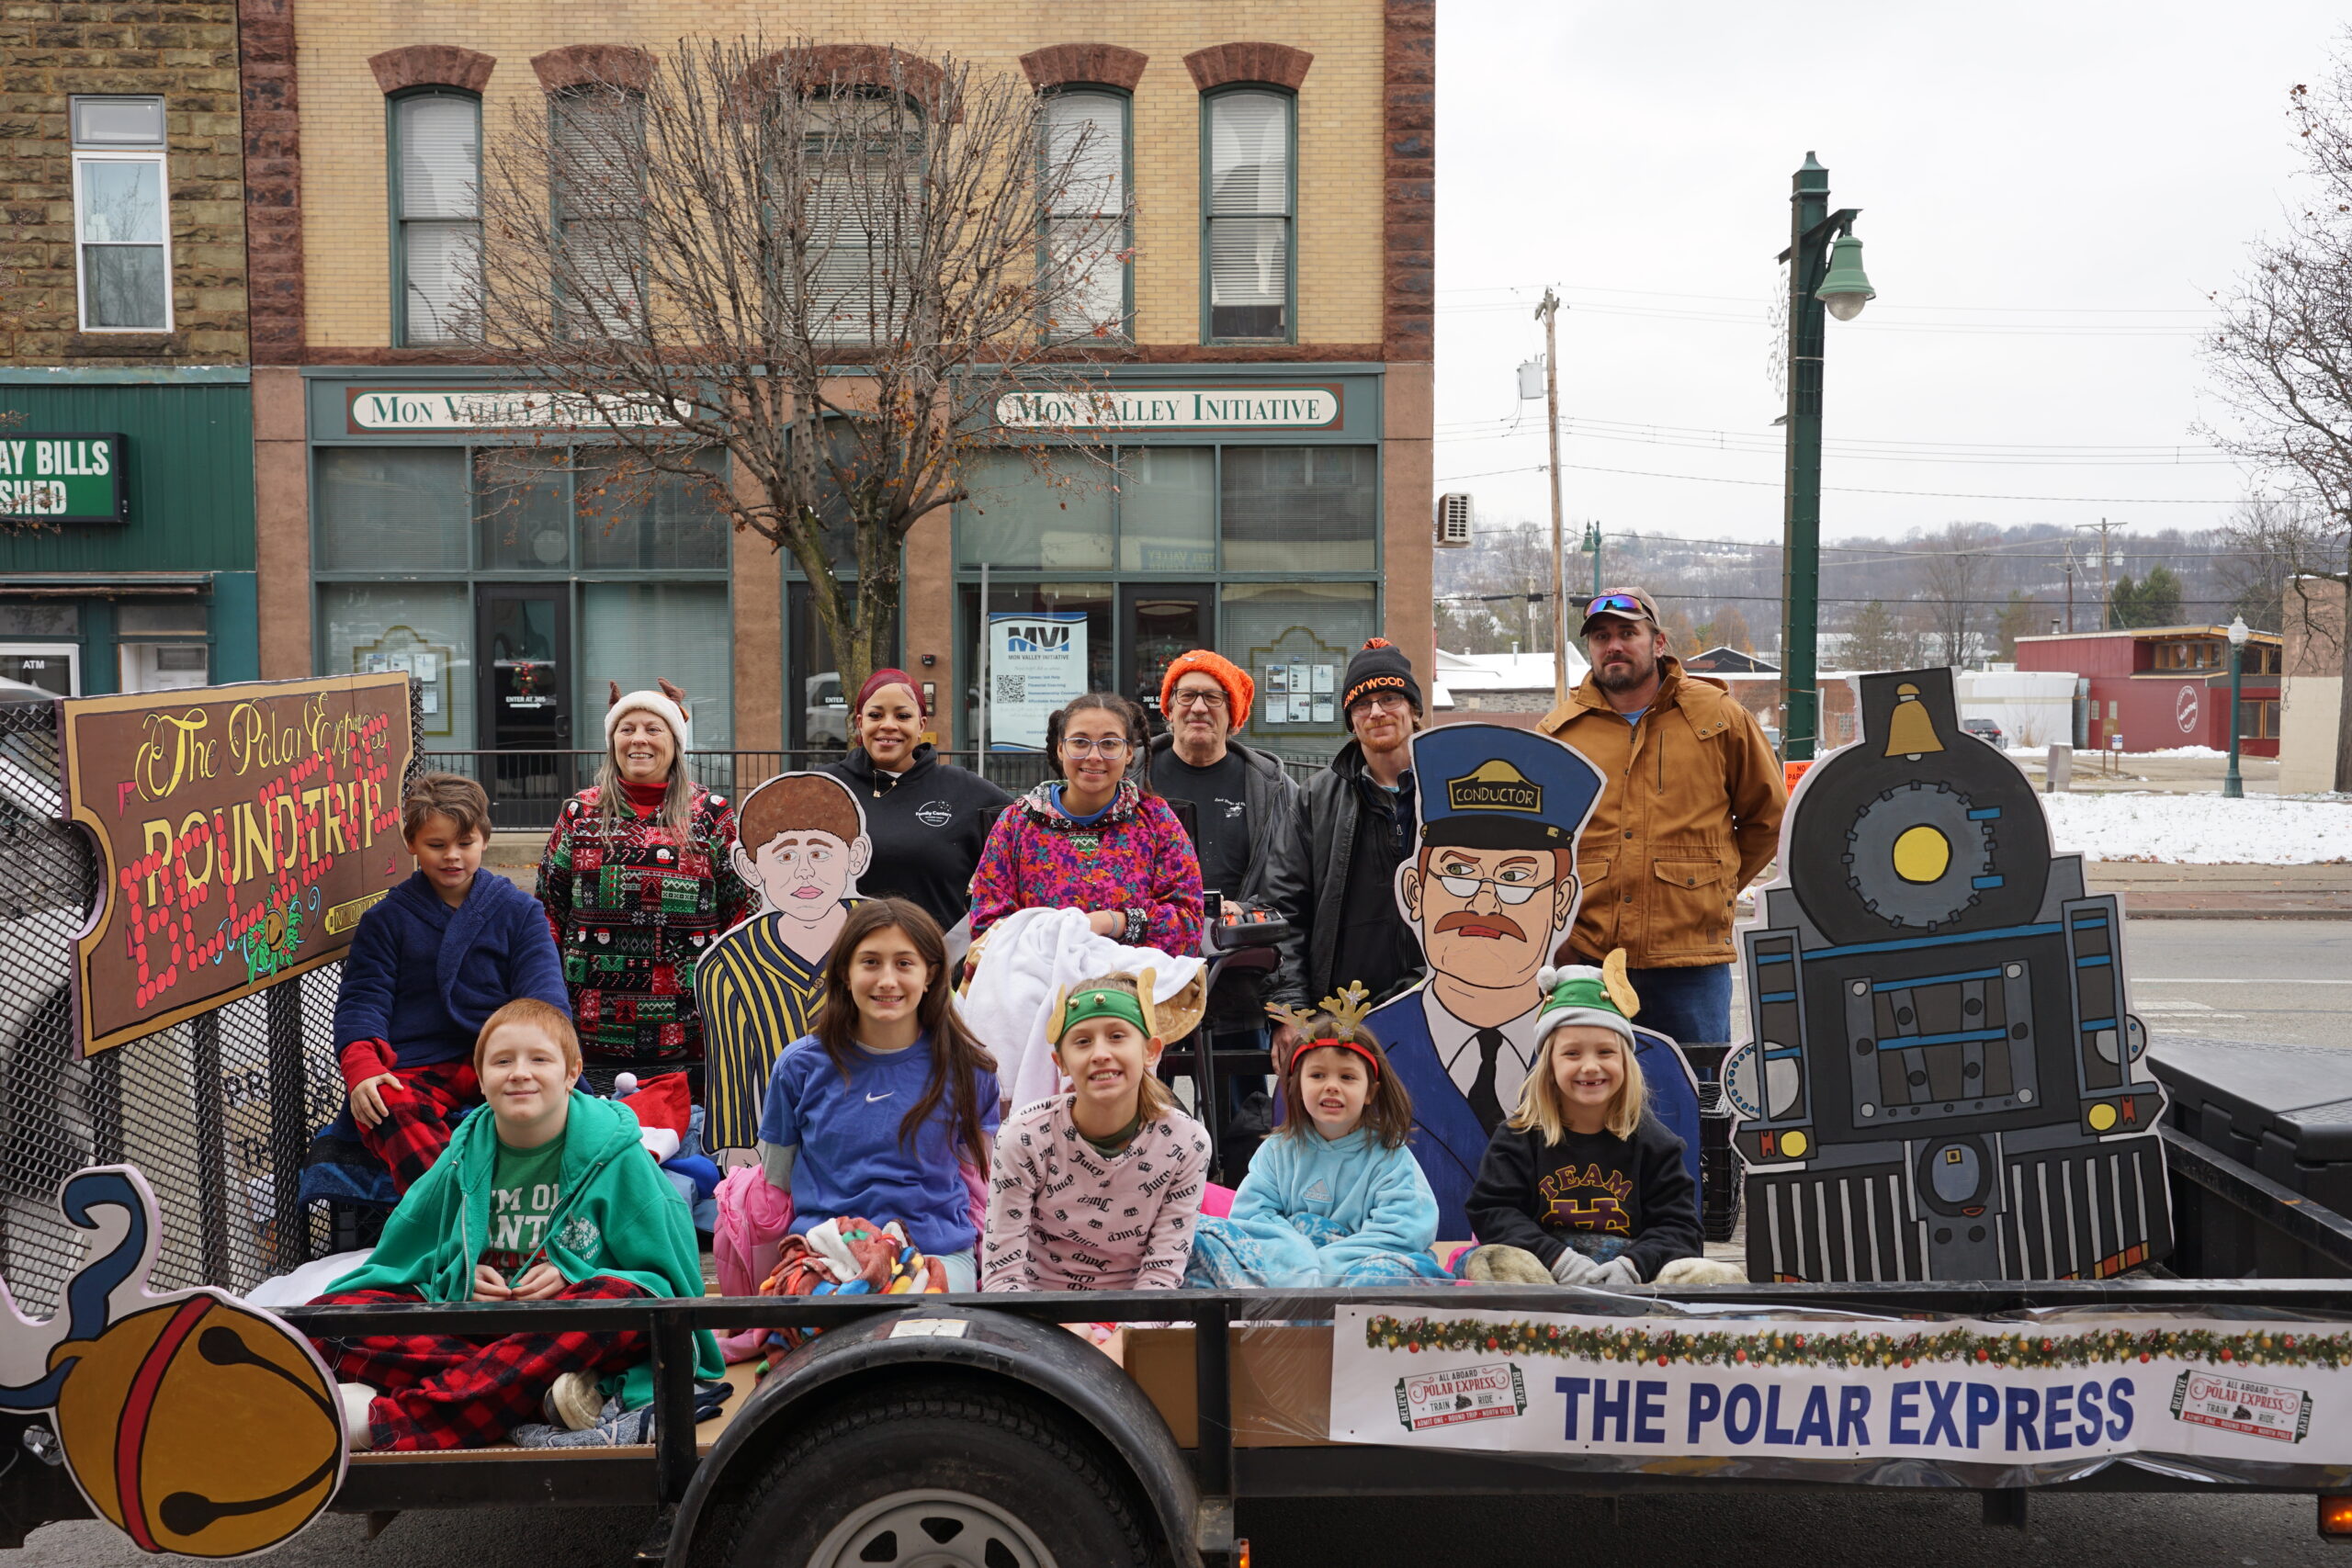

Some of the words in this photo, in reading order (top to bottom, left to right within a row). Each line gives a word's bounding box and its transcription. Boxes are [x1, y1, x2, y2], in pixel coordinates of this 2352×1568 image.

[370, 396, 434, 423] MON
[1015, 395, 1077, 422] MON
[1088, 394, 1181, 421] VALLEY
[1192, 394, 1320, 421] INITIATIVE
[36, 441, 109, 476] BILLS
[1008, 626, 1069, 651] MVI
[23, 660, 44, 669] ATM
[135, 707, 220, 802] The
[228, 698, 301, 776] Polar
[1456, 787, 1534, 805] CONDUCTOR
[1069, 1150, 1104, 1178] Juicy
[1046, 1174, 1075, 1198] Juicy
[1539, 1164, 1633, 1201] TEAM
[490, 1187, 523, 1213] 'M
[1077, 1194, 1114, 1213] Juicy
[1107, 1224, 1148, 1242] Juicy
[985, 1249, 1023, 1275] Juicy
[1423, 1382, 1454, 1396] POLAR
[1454, 1376, 1497, 1393] EXPRESS
[1439, 1373, 1451, 1382] ALL
[1452, 1369, 1478, 1380] ABOARD
[1511, 1371, 1526, 1405] BELIEVE
[2226, 1381, 2238, 1389] ALL
[2241, 1383, 2269, 1394] ABOARD
[1396, 1388, 1409, 1422] BELIEVE
[1430, 1401, 1451, 1412] TRAIN
[1477, 1395, 1493, 1404] RIDE
[2172, 1377, 2188, 1410] BELIEVE
[2206, 1385, 2237, 1403] POLAR
[2240, 1392, 2284, 1411] EXPRESS
[1417, 1417, 1433, 1427] ADMIT
[1434, 1416, 1444, 1424] ONE
[1448, 1414, 1465, 1422] ROUND
[1466, 1411, 1478, 1420] TRIP
[1482, 1408, 1499, 1417] NORTH
[1499, 1407, 1512, 1416] POLE
[1555, 1376, 1668, 1443] THE
[1687, 1382, 1871, 1447] POLAR
[1889, 1377, 2135, 1451] EXPRESS
[2186, 1412, 2203, 1422] ADMIT
[2204, 1416, 2216, 1425] ONE
[2221, 1419, 2240, 1430] ROUND
[2241, 1423, 2254, 1432] TRIP
[2257, 1427, 2276, 1437] NORTH
[2276, 1430, 2290, 1439] POLE
[2207, 1403, 2229, 1416] TRAIN
[2258, 1413, 2276, 1424] RIDE
[2297, 1402, 2312, 1434] BELIEVE
